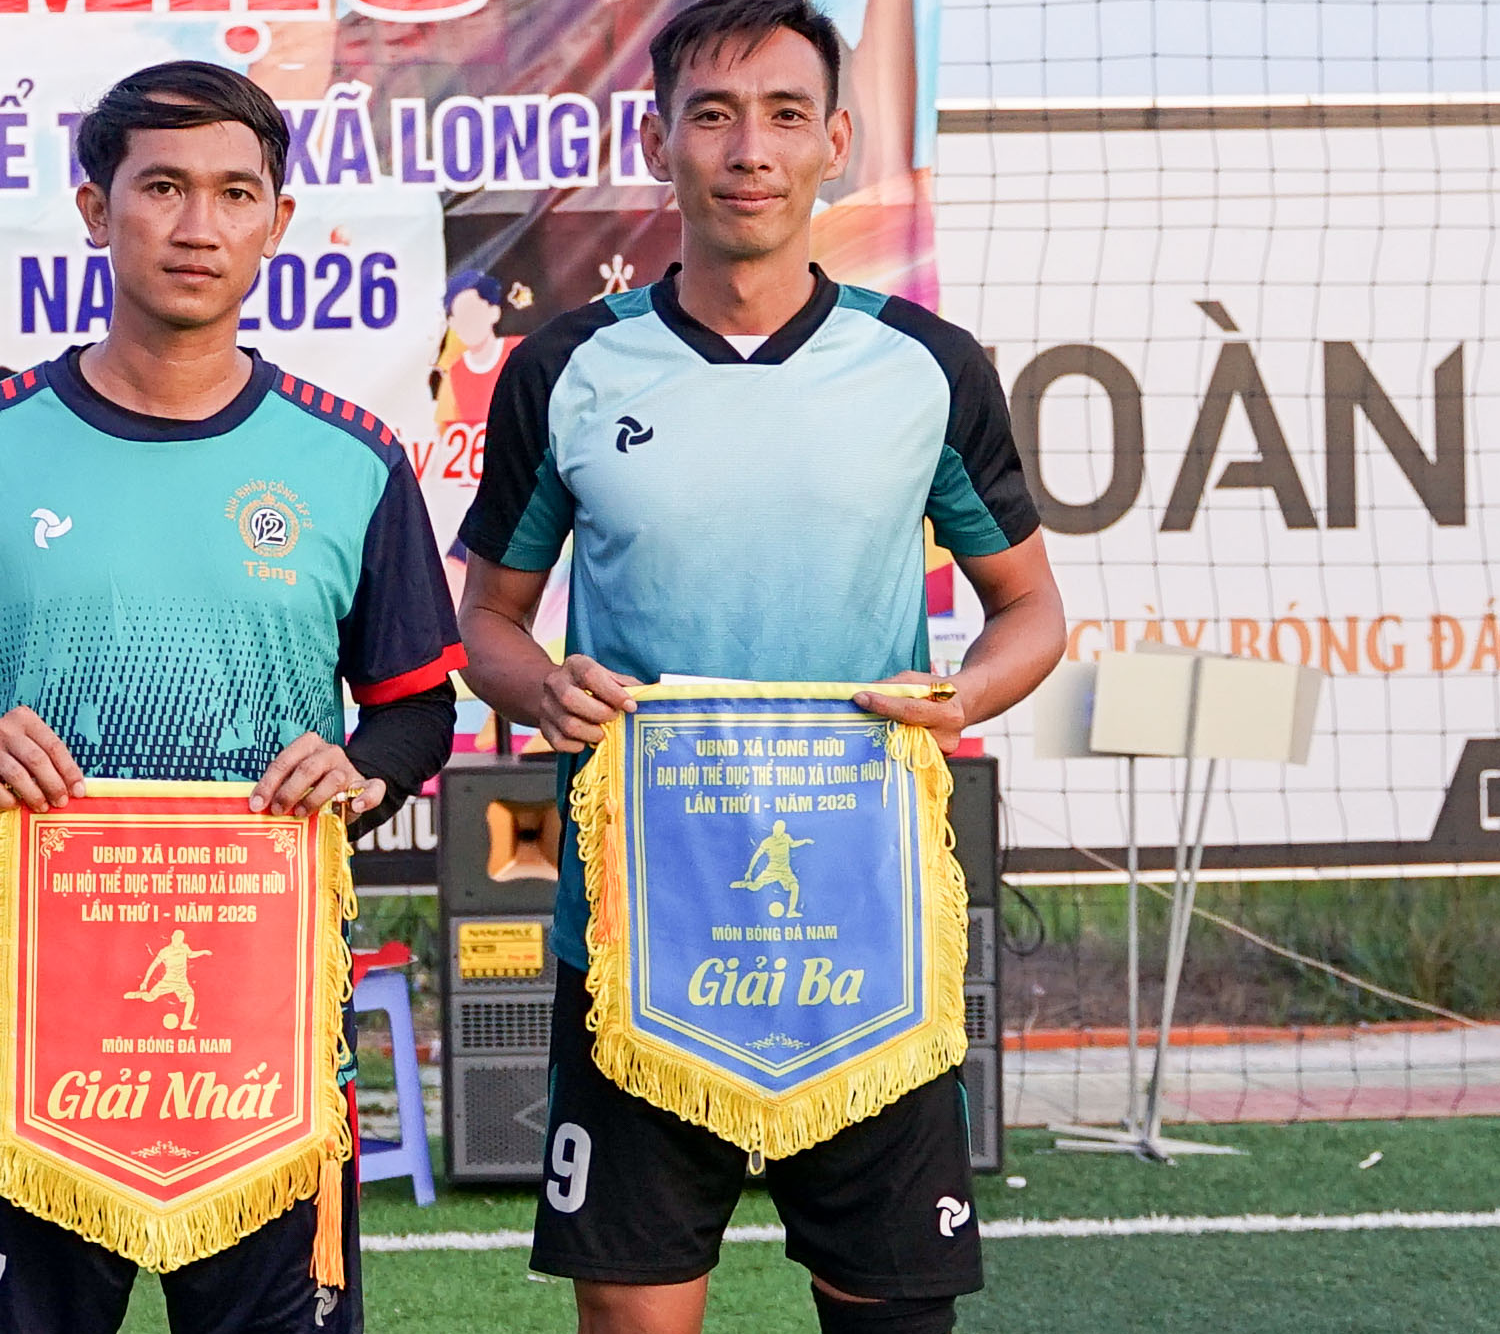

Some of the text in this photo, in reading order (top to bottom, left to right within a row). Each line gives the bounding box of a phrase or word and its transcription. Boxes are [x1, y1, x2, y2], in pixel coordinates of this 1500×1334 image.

[279, 91, 374, 185] XÃ
[400, 99, 590, 185] LONG
[20, 237, 115, 333] NĂ
[985, 301, 1467, 535] OÀN
[696, 736, 845, 757] UBND XÃ LONG HỮU
[656, 765, 676, 790] ĐẠI
[679, 762, 699, 790] HỘI
[702, 758, 725, 786] THỂ
[726, 765, 750, 790] DỤC
[752, 758, 774, 786] THỂ
[776, 765, 807, 786] THAO
[808, 762, 825, 786] XÃ
[827, 764, 859, 784] LONG
[685, 790, 716, 814] LẦN
[720, 794, 753, 813] THỨ
[775, 793, 813, 813] NĂM
[818, 794, 857, 811] 2026
[93, 843, 248, 864] UBND XÃ LONG HỮU
[53, 866, 286, 898] ĐẠI HỘI THỂ DỤC THỂ THAO XÃ LONG HỮU
[81, 898, 113, 922] LẦN
[118, 901, 151, 922] THỨ
[153, 905, 158, 922] I
[175, 902, 213, 922] NĂM
[218, 905, 257, 922] 2026
[712, 923, 838, 941] MÔN BÓNG ĐÁ NAM
[688, 955, 865, 1007] Giải Ba
[102, 1036, 232, 1053] MÔN BÓNG ĐÁ NAM
[47, 1062, 282, 1119] Giải Nhất
[546, 1121, 592, 1213] 9
